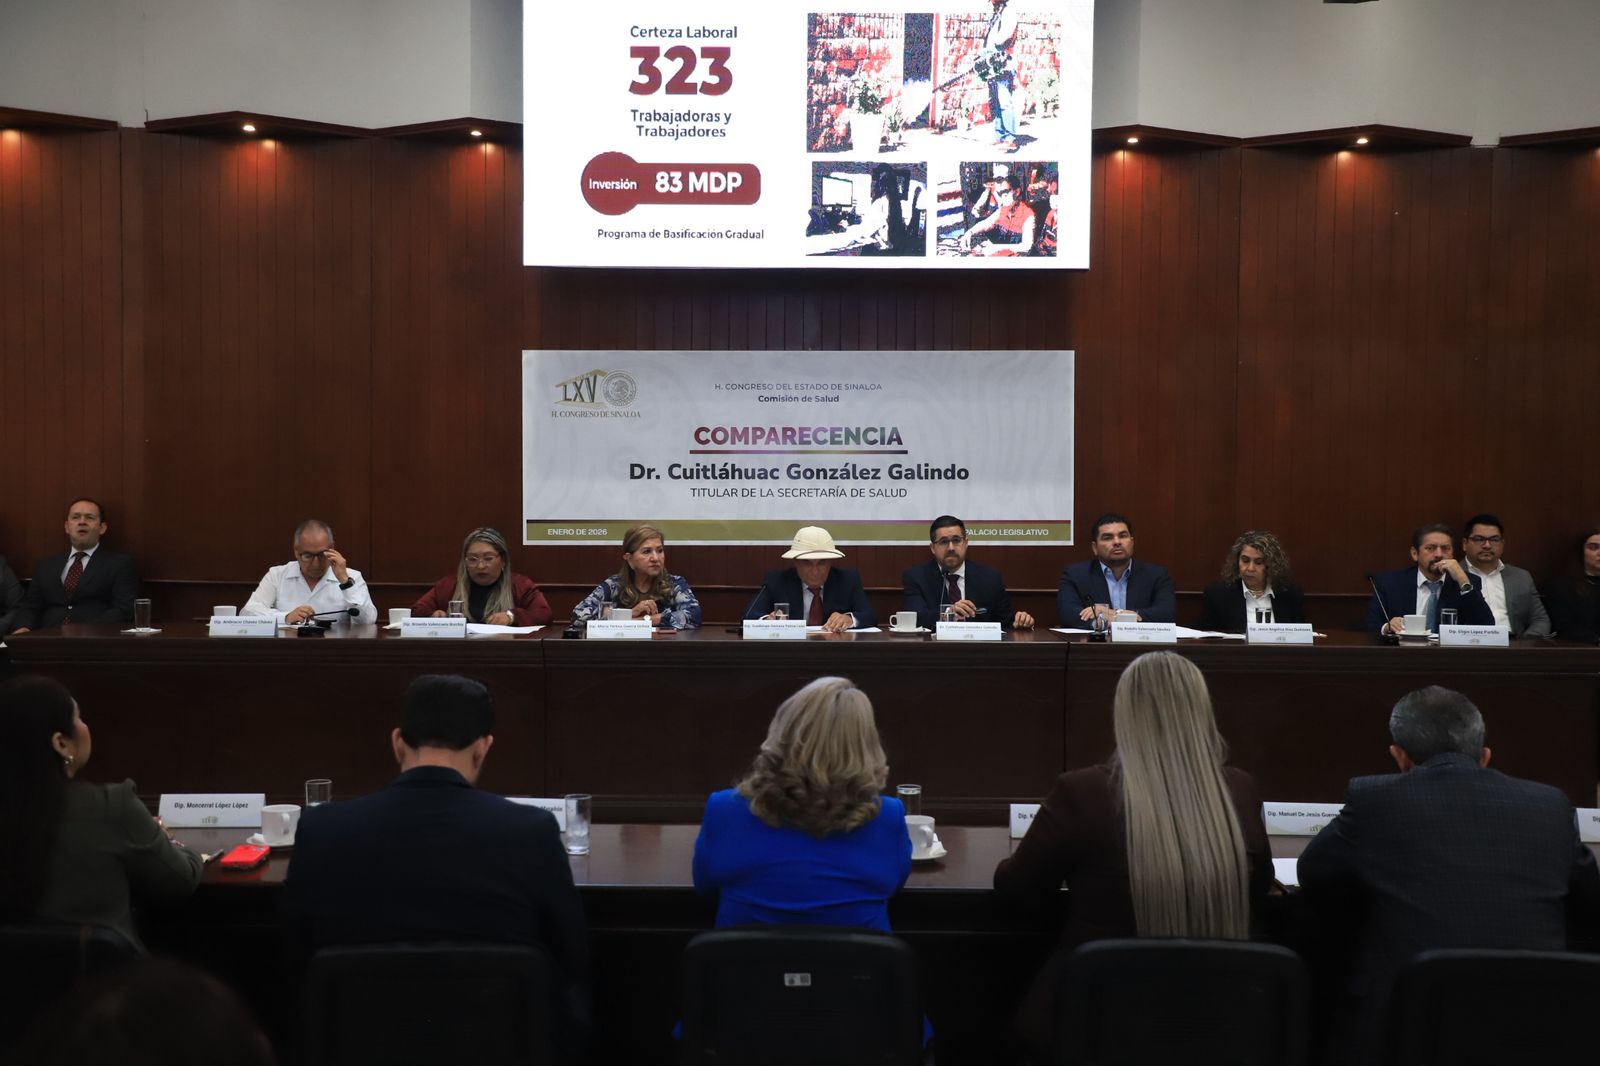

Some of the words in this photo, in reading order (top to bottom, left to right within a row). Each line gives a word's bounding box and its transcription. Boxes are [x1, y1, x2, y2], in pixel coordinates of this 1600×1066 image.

[630, 25, 683, 39] Certeza
[686, 26, 738, 39] Laboral
[628, 45, 733, 96] 323
[630, 109, 721, 126] Trabajadoras
[723, 113, 732, 126] y
[636, 125, 726, 141] Trabajadores
[589, 178, 638, 190] Inversión
[655, 171, 683, 194] 83
[688, 171, 743, 194] MDP
[597, 228, 647, 240] Programa
[648, 228, 661, 239] de
[663, 228, 723, 239] Basificación
[725, 229, 764, 239] Gradual
[562, 374, 598, 403] LXV
[714, 383, 724, 391] H.
[724, 383, 774, 391] CONGRESO
[775, 383, 793, 391] DEL
[794, 383, 829, 391] ESTADO
[830, 383, 843, 391] DE
[844, 383, 882, 391] SINALOA
[757, 394, 799, 404] Comisión
[801, 394, 812, 403] de
[814, 394, 840, 403] Salud
[551, 410, 560, 418] H.
[560, 410, 599, 418] CONGRESO
[600, 410, 610, 418] DE
[610, 410, 641, 418] SINALOA
[693, 426, 904, 446] COMPARECENCIA
[629, 463, 661, 480] Dr.
[667, 462, 780, 480] Cuitláhuac
[786, 462, 881, 481] González
[887, 462, 970, 481] Galindo
[690, 487, 738, 498] TITULAR
[741, 487, 757, 498] DE
[759, 487, 775, 498] LA
[777, 486, 848, 498] SECRETARÍA
[850, 487, 866, 498] DE
[868, 487, 908, 498] SALUD
[547, 528, 574, 536] ENERO
[575, 528, 587, 536] DE
[587, 528, 608, 536] 2026
[999, 528, 1049, 536] LEGISLATIVO
[1018, 812, 1028, 820] Dip.
